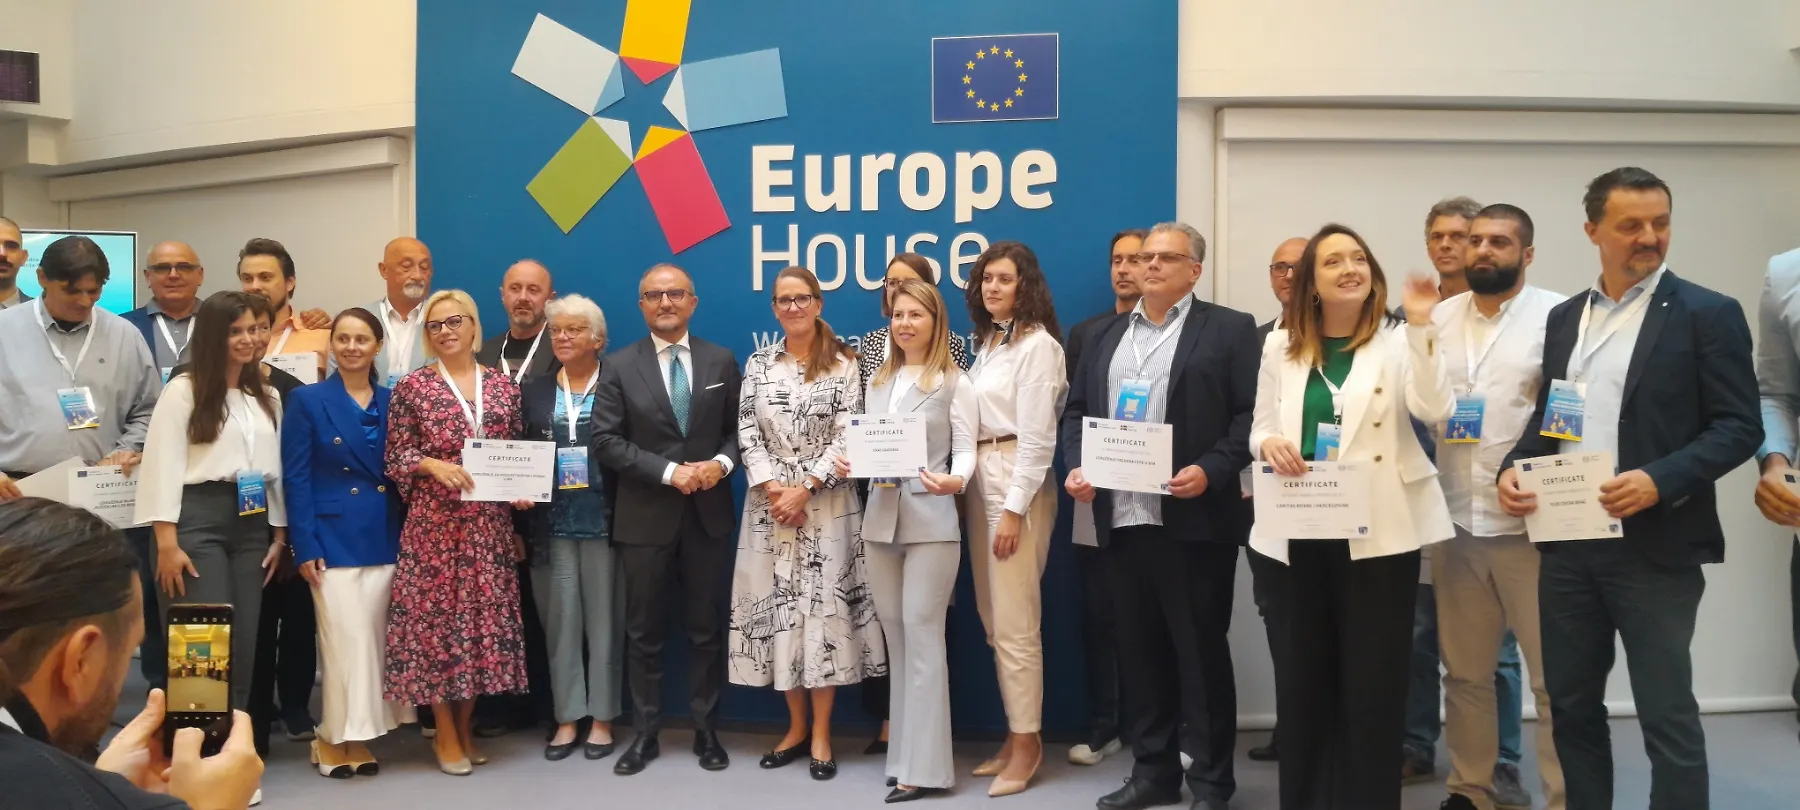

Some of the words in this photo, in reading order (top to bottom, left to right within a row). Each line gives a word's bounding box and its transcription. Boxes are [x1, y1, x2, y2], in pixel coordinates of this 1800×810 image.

[752, 144, 1057, 223] Europe
[752, 223, 990, 291] House
[1103, 437, 1146, 447] CERTIFICATE
[96, 480, 138, 489] CERTIFICAT
[1542, 475, 1585, 485] CERTIFICATE
